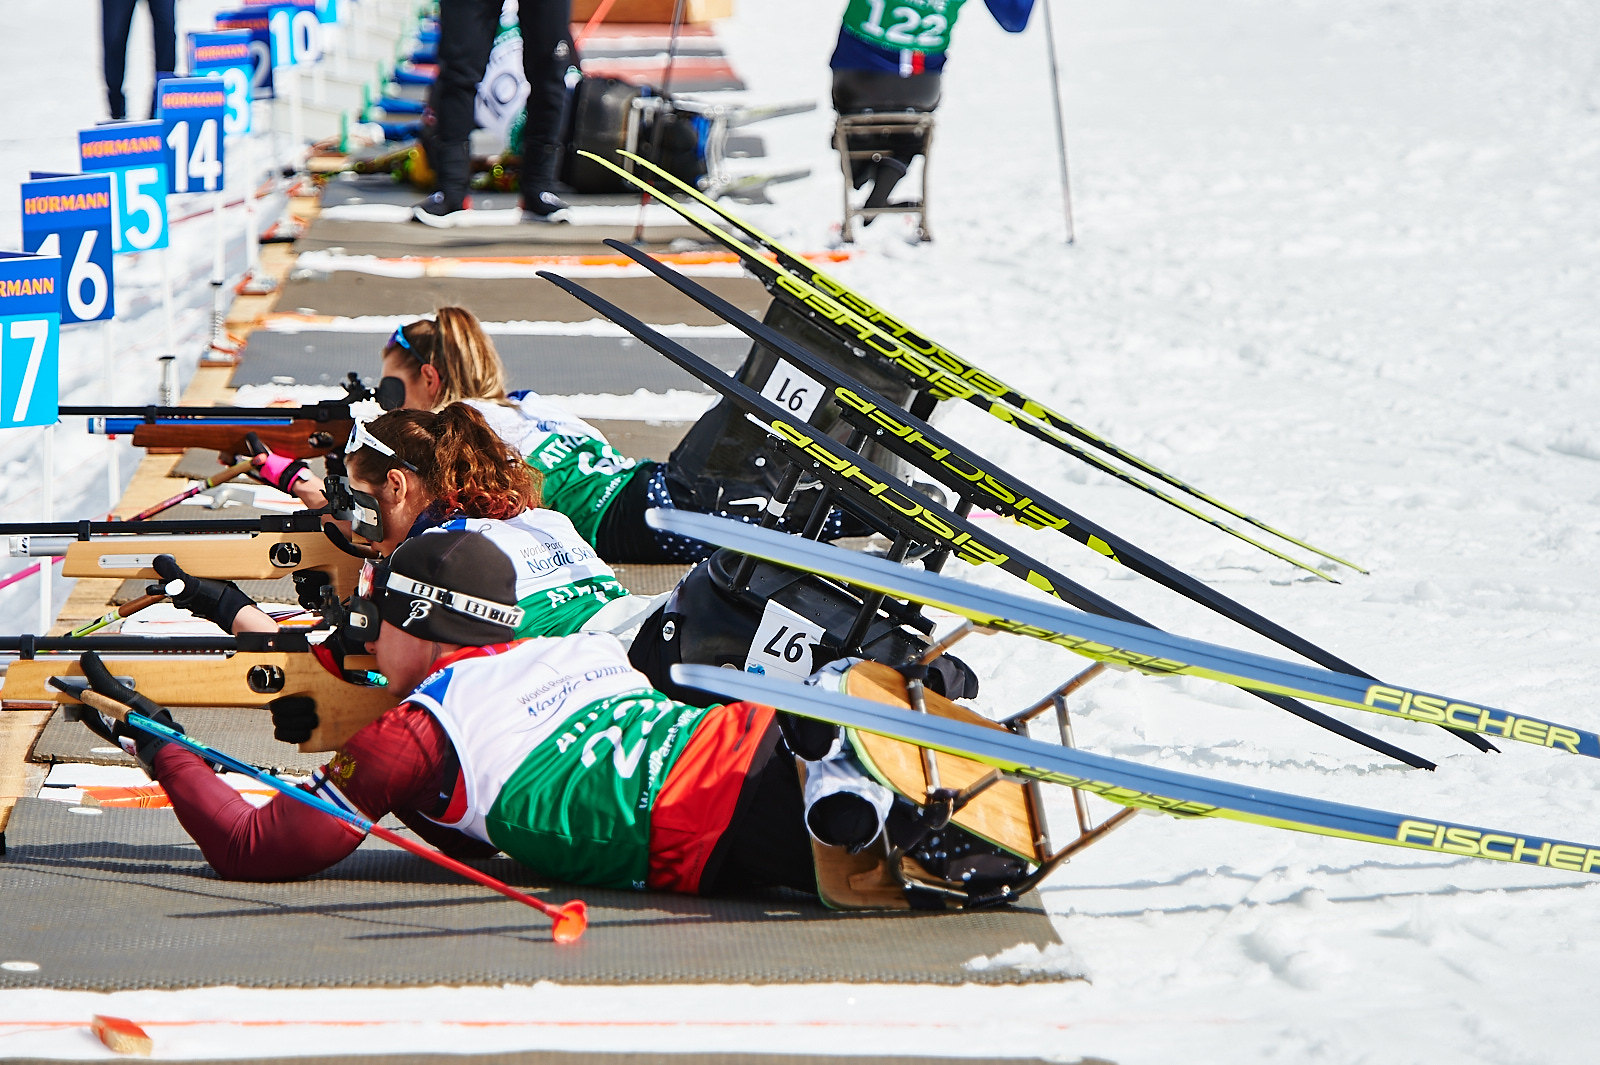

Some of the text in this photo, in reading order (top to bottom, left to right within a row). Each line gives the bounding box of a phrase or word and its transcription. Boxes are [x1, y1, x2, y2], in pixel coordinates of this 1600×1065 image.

[860, 0, 948, 46] 122
[166, 119, 223, 192] 14
[776, 275, 977, 400] FISCHER
[812, 272, 1010, 397] FISCHER
[771, 419, 1009, 565] FISCHER
[835, 386, 1070, 530] FISCHER
[526, 550, 575, 574] Nordic
[1364, 685, 1581, 754] FISCHER
